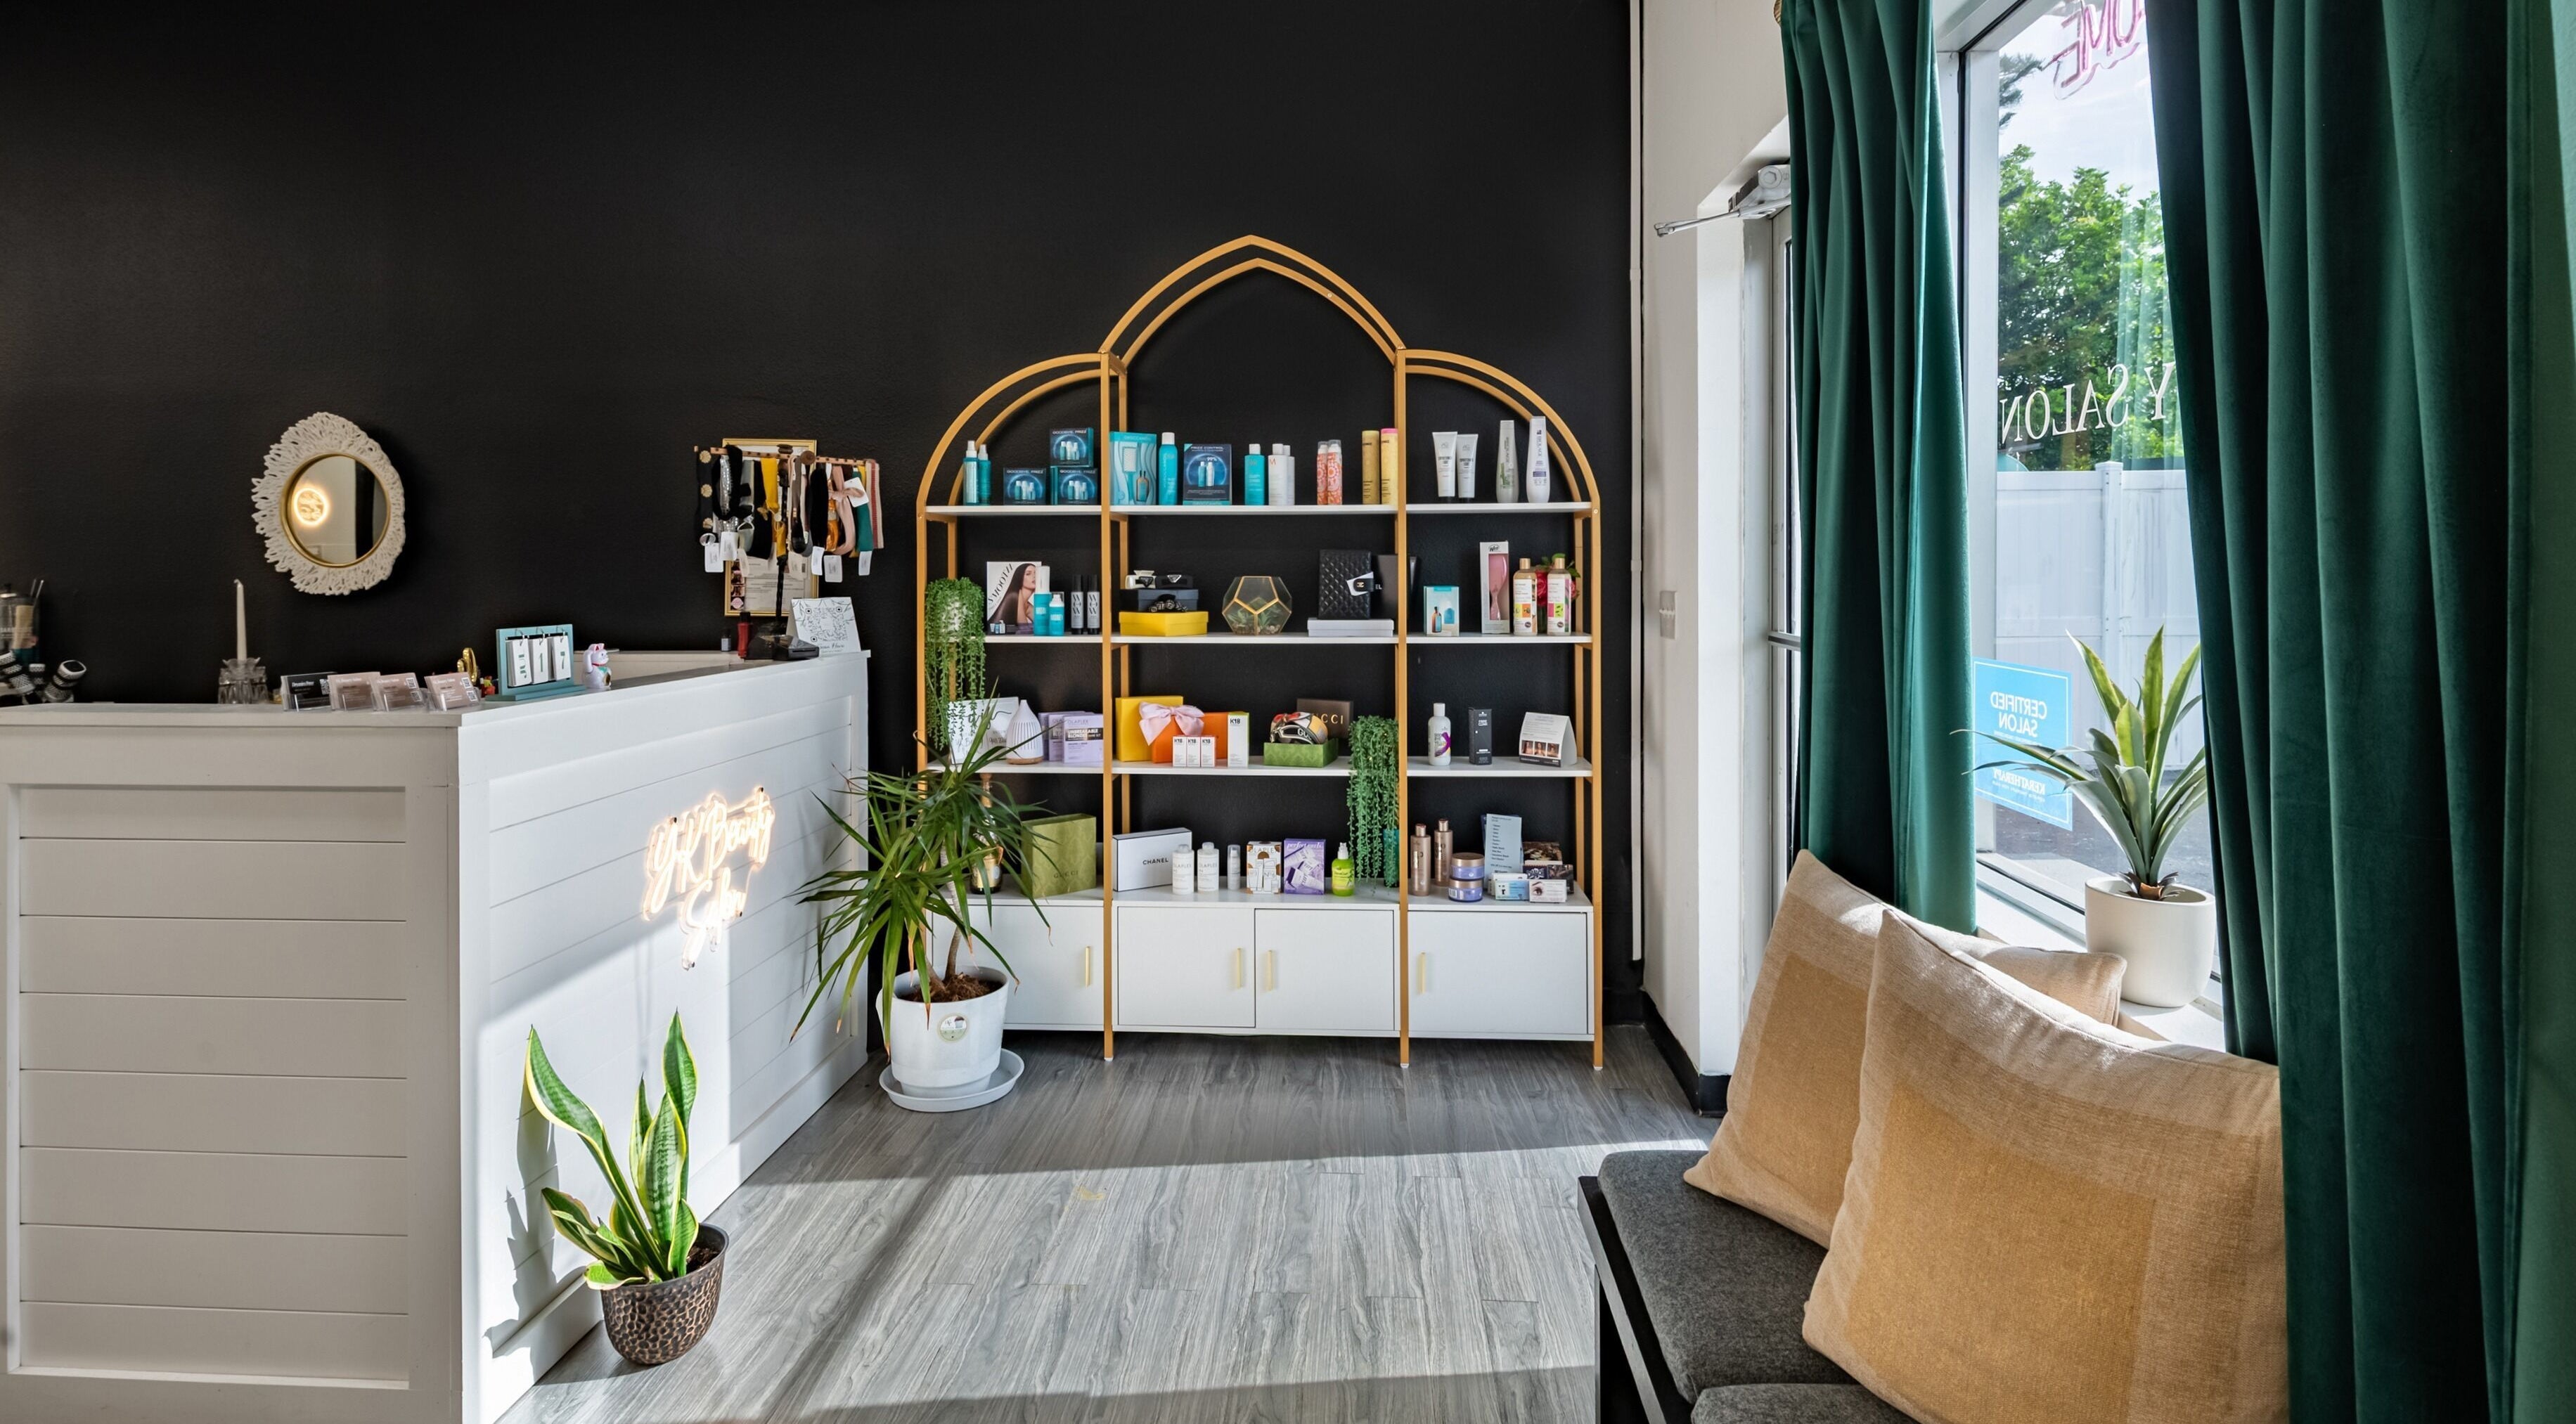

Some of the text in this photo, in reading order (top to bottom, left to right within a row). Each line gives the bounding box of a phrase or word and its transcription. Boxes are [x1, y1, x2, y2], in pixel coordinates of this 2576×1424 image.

[988, 562, 1013, 604] SMOOTH
[560, 651, 565, 670] 7
[1321, 713, 1344, 724] CCI
[704, 787, 773, 877] Beauty
[1142, 857, 1169, 865] CHANEL
